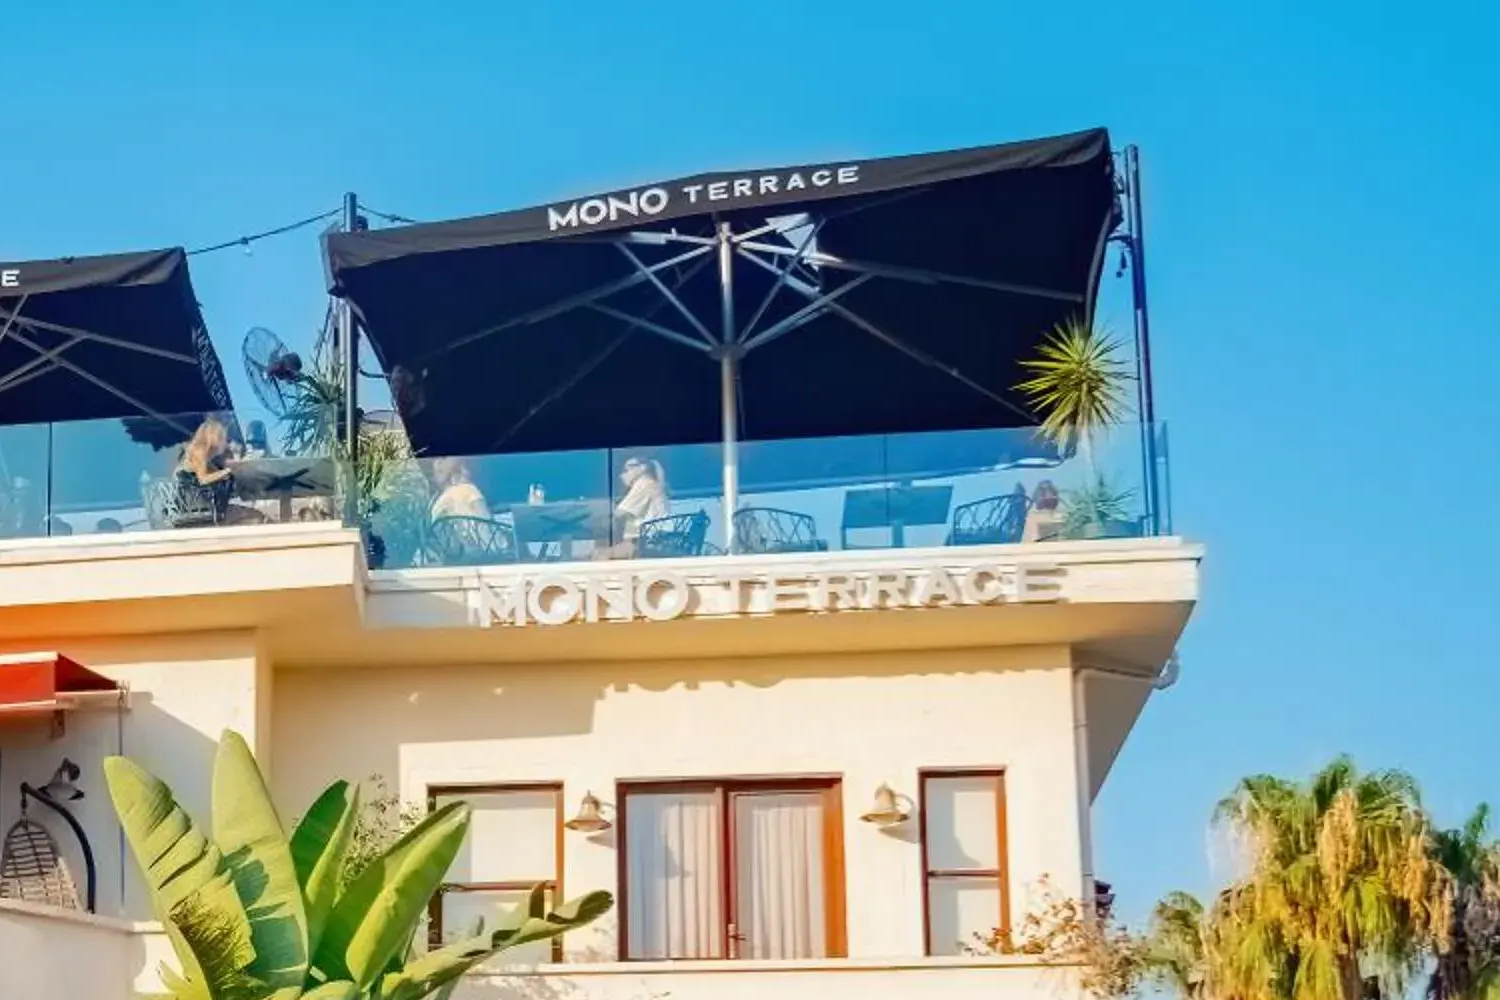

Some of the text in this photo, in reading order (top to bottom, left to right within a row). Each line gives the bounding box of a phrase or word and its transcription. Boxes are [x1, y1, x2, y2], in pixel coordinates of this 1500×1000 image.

[547, 165, 860, 231] MONO TERRACE
[472, 561, 1068, 628] MONO TERRACE
